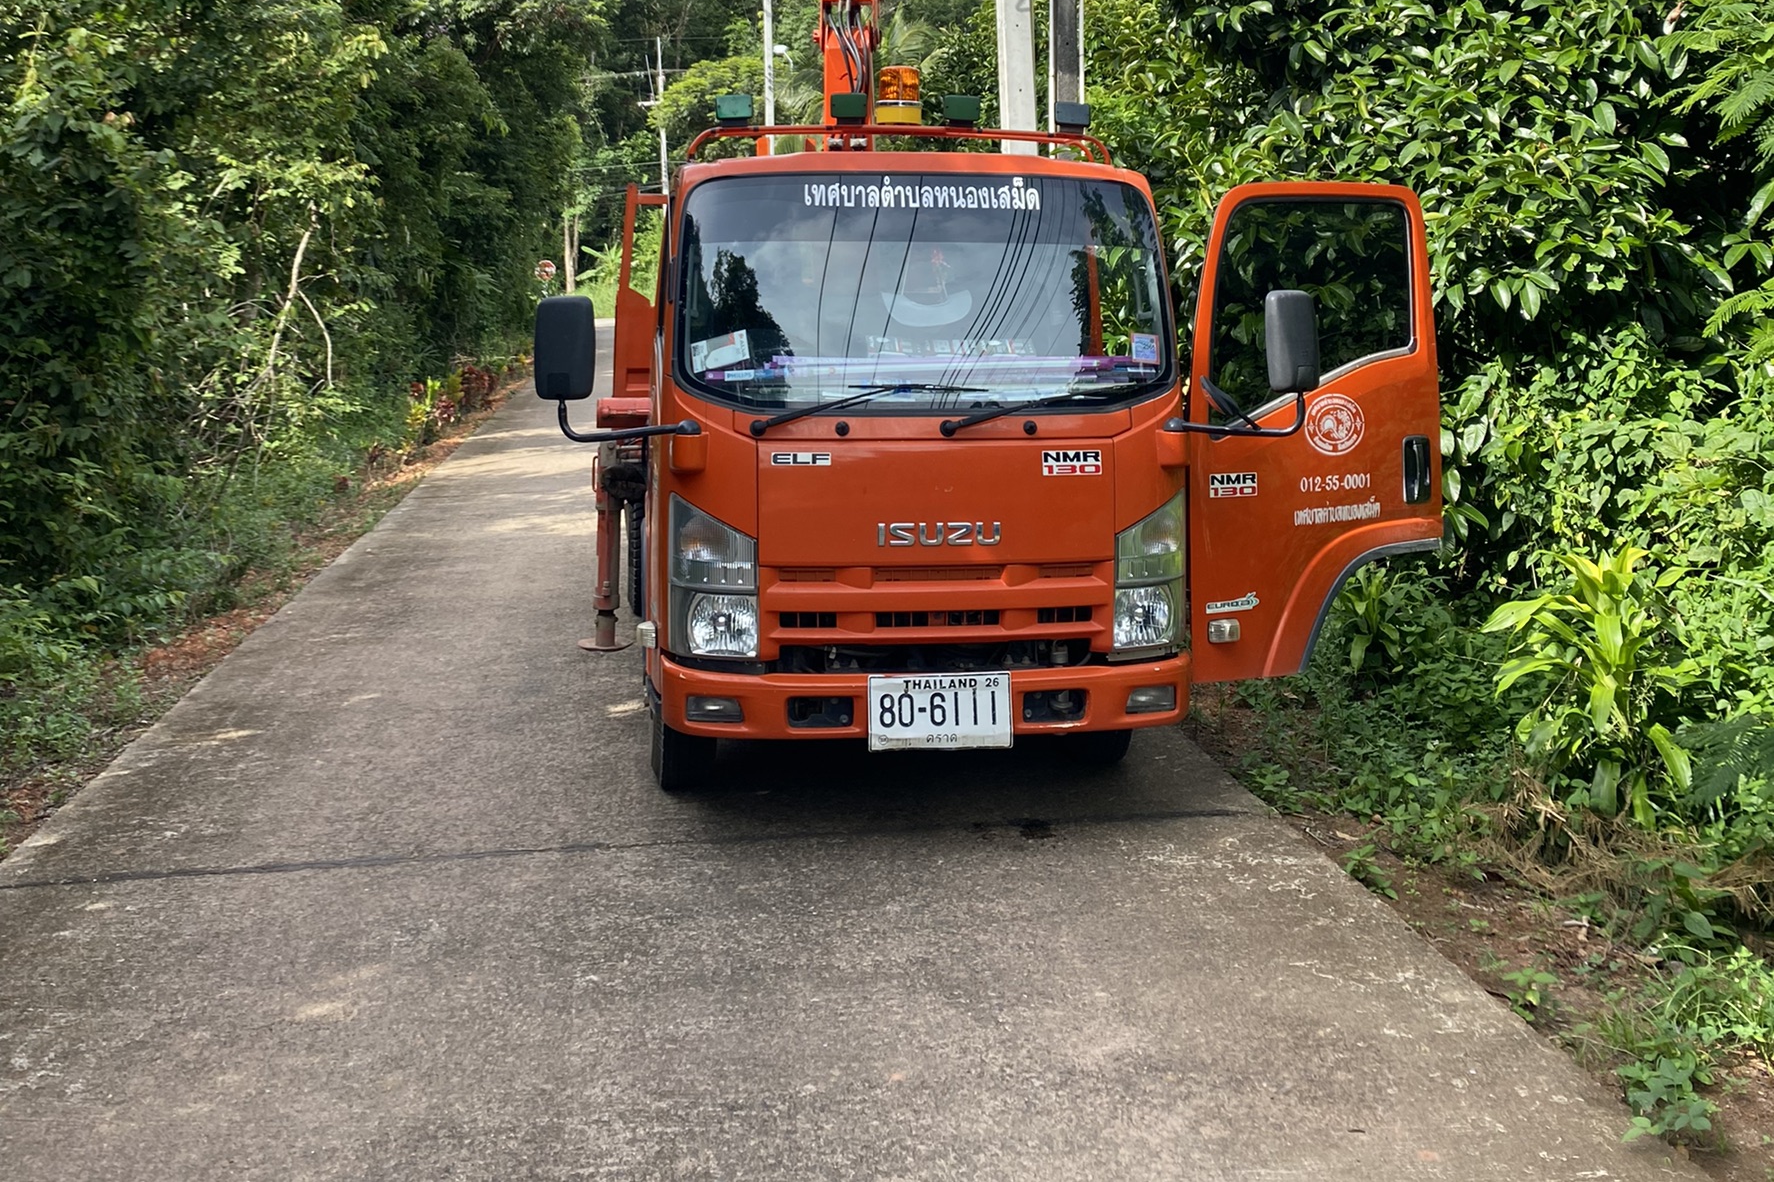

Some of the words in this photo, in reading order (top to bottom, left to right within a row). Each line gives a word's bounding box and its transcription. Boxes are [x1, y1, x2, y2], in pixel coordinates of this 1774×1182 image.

[803, 175, 1041, 211] เทศบาลตำบลหนองเสม็ด
[772, 453, 830, 465] ELF
[1043, 451, 1101, 463] NMR
[1044, 464, 1101, 474] 130
[1210, 473, 1256, 486] NMR
[1300, 473, 1371, 492] 012-55-0001
[1210, 485, 1257, 497] 130
[877, 521, 1002, 546] ISUZU
[903, 678, 978, 690] THAILAND
[985, 677, 1000, 688] 26
[879, 690, 997, 729] 80-6111
